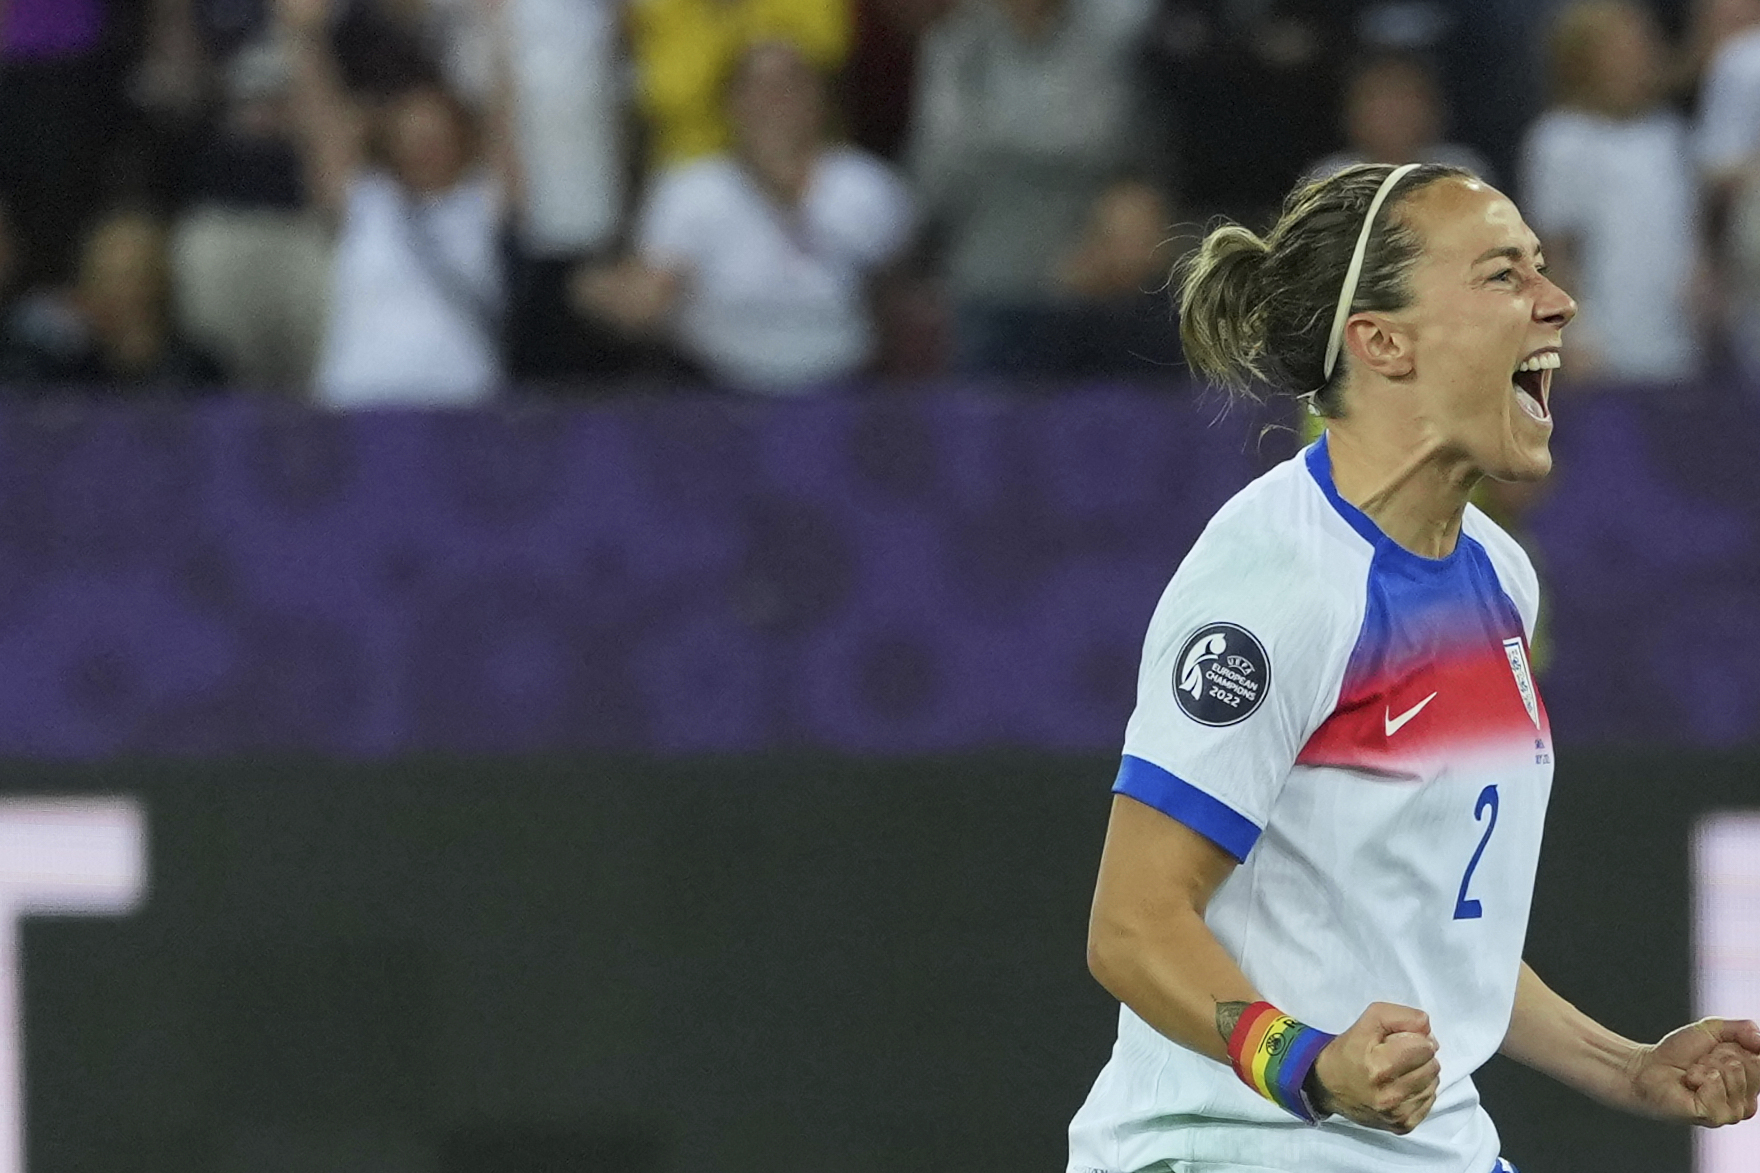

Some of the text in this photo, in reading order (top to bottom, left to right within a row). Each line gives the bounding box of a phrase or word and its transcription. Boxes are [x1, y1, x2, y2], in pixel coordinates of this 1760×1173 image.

[1205, 670, 1257, 701] CHAMPIONS
[1211, 662, 1259, 691] EUROPEAN
[1209, 686, 1240, 708] 2022
[1453, 783, 1499, 921] 2
